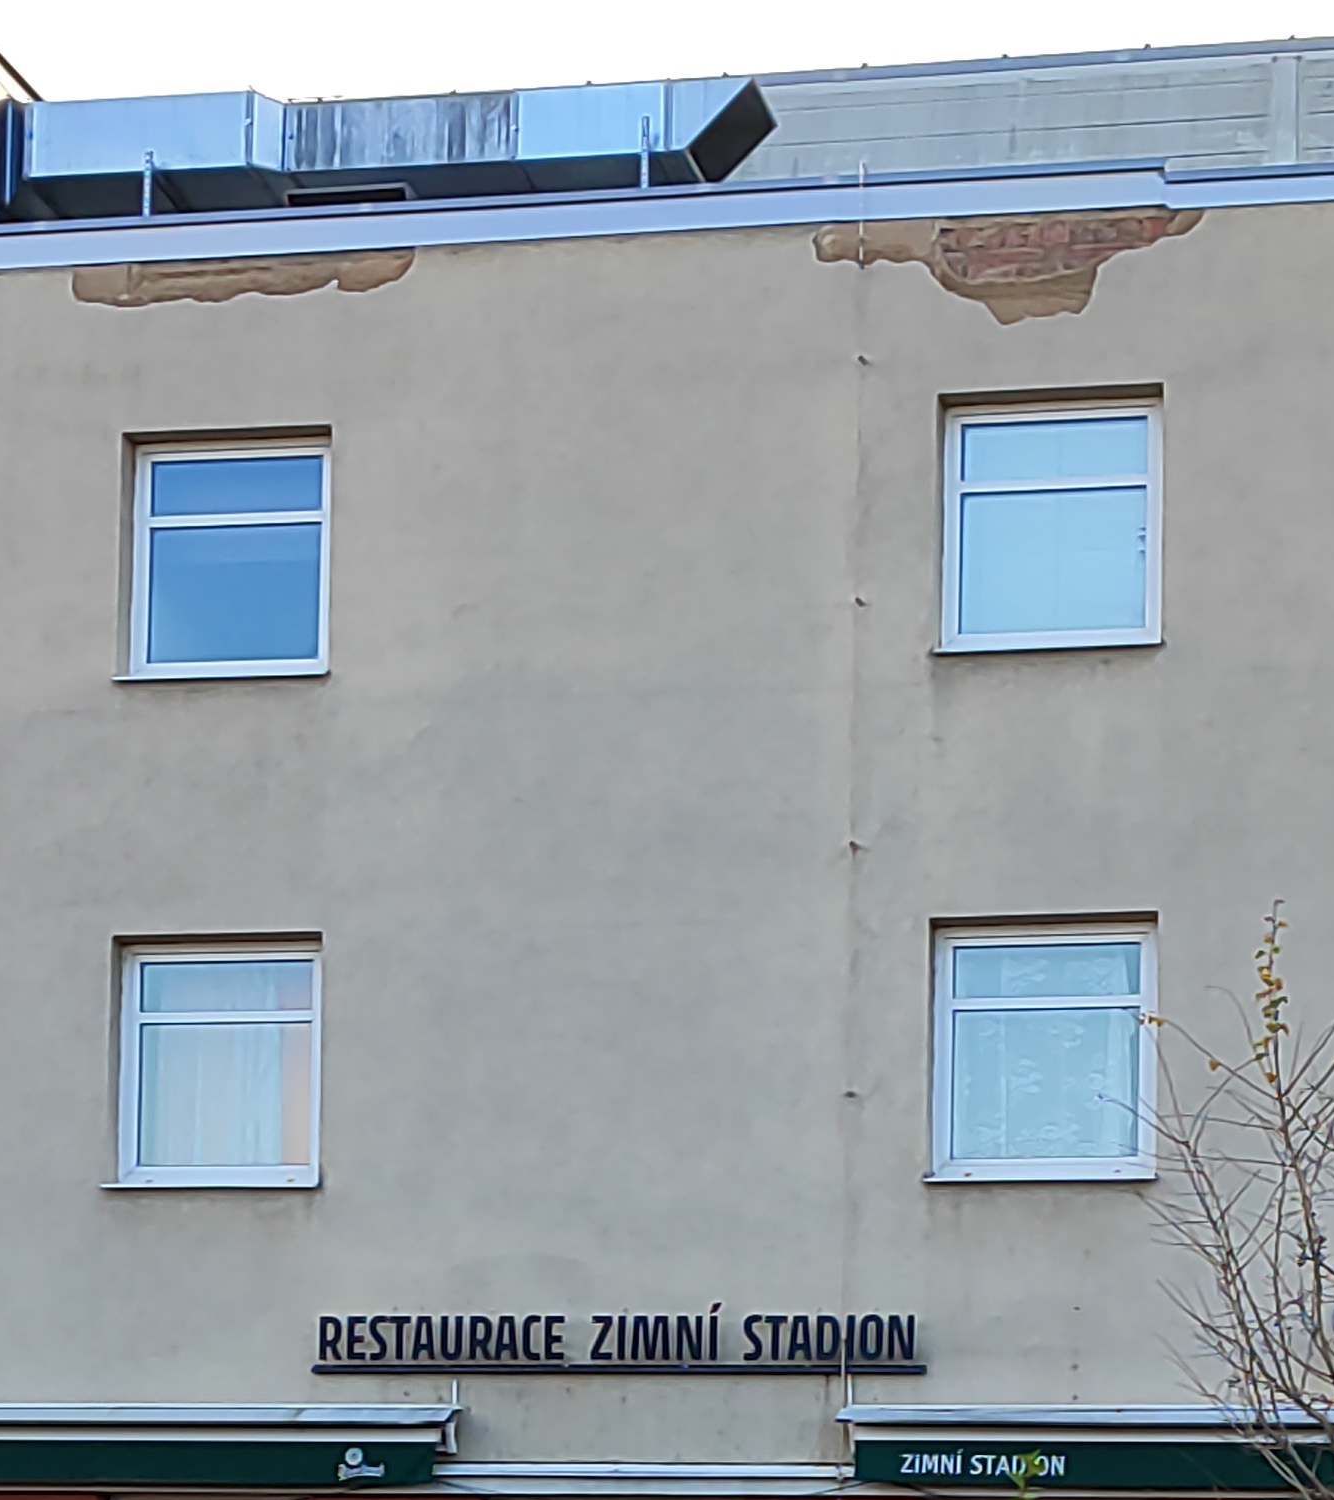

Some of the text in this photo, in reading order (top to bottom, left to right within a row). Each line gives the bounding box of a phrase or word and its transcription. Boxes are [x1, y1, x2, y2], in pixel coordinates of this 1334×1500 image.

[319, 1302, 915, 1361] RESTAURACE ZIMNÍ STADION
[899, 1448, 1066, 1477] ZIMNÍ STADON
